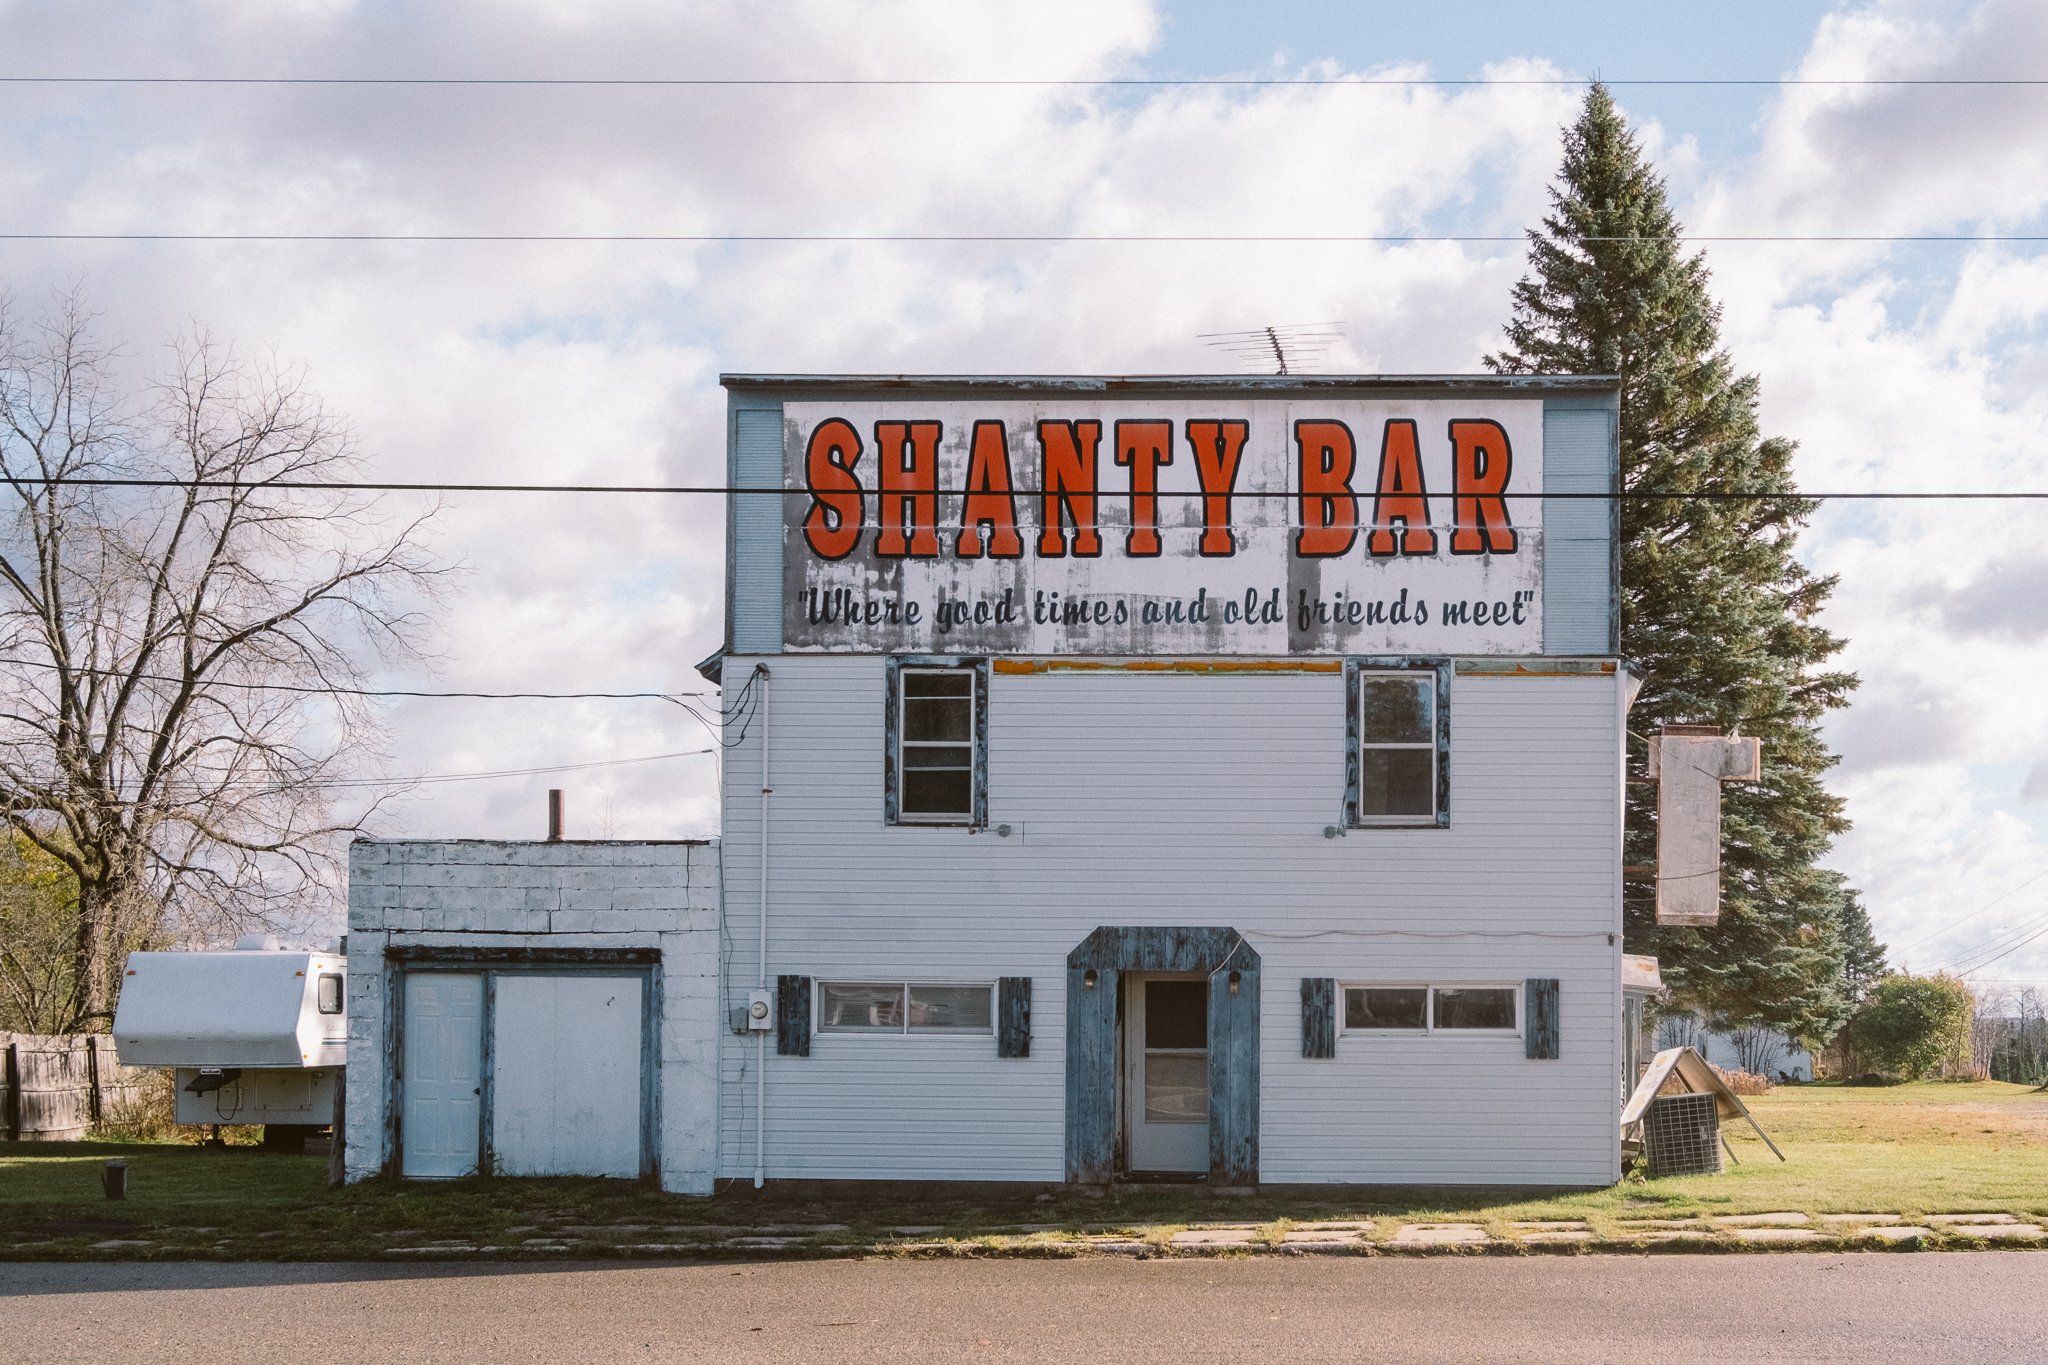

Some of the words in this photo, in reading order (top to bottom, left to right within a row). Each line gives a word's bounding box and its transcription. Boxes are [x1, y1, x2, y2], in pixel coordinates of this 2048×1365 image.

[802, 417, 1249, 561] SHANTY
[1294, 418, 1518, 558] BAR
[799, 587, 923, 626] "Where
[936, 588, 1018, 634] good
[1034, 591, 1129, 626] times
[1141, 587, 1210, 626] and
[1224, 587, 1283, 625] old
[1298, 587, 1429, 632] friends
[1442, 590, 1534, 626] meet"
